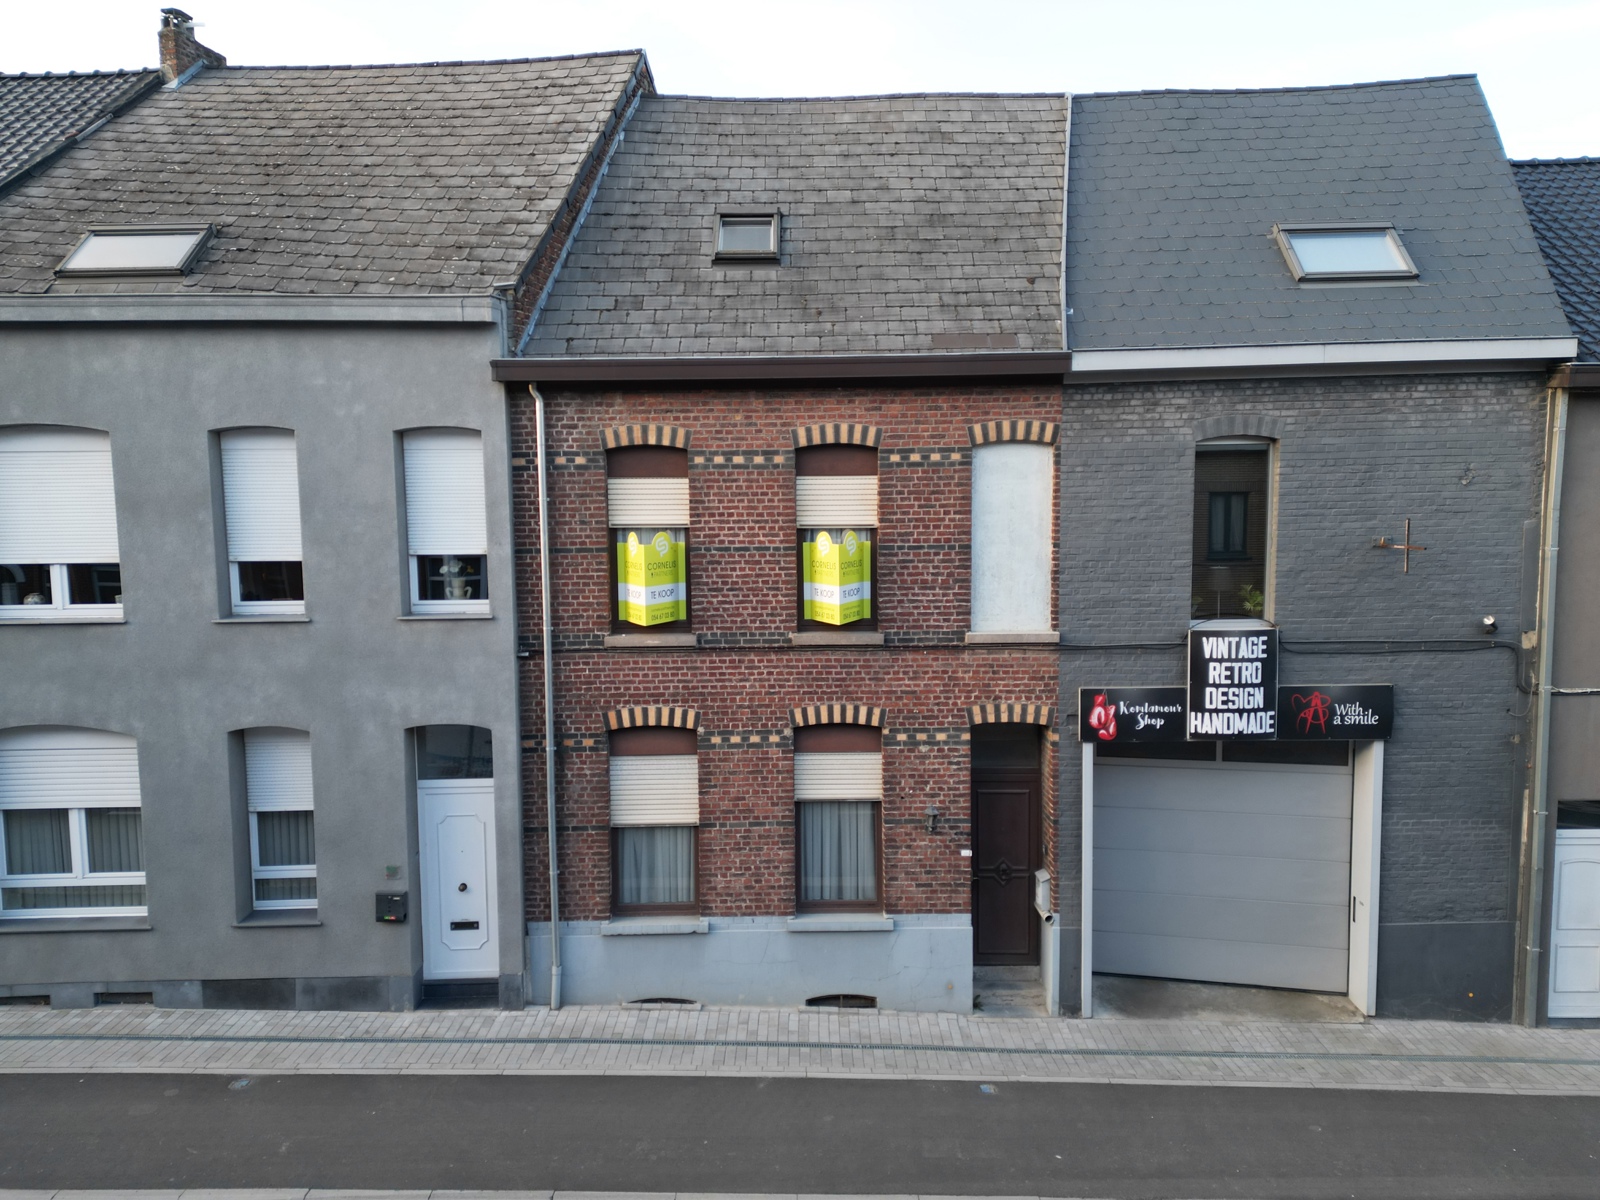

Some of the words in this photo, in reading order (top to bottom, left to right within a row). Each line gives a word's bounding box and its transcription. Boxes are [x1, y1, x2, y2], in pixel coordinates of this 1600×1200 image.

[647, 560, 677, 571] CORNELIS
[811, 560, 837, 570] CORNELIS
[840, 559, 863, 570] CORNELIS
[650, 590, 657, 599] TE
[658, 588, 675, 598] KOOP
[814, 587, 819, 597] TE
[820, 589, 835, 598] KOOP
[842, 589, 847, 598] TE
[847, 587, 861, 597] KOOP
[1202, 636, 1268, 659] VINTAGE
[1208, 661, 1262, 684] RETRO
[1205, 687, 1264, 709] DESIGN
[1334, 701, 1364, 716] With
[1135, 713, 1165, 730] Shop
[1190, 711, 1275, 734] HANDMADE
[1333, 715, 1342, 725] a
[1344, 708, 1379, 725] smile
